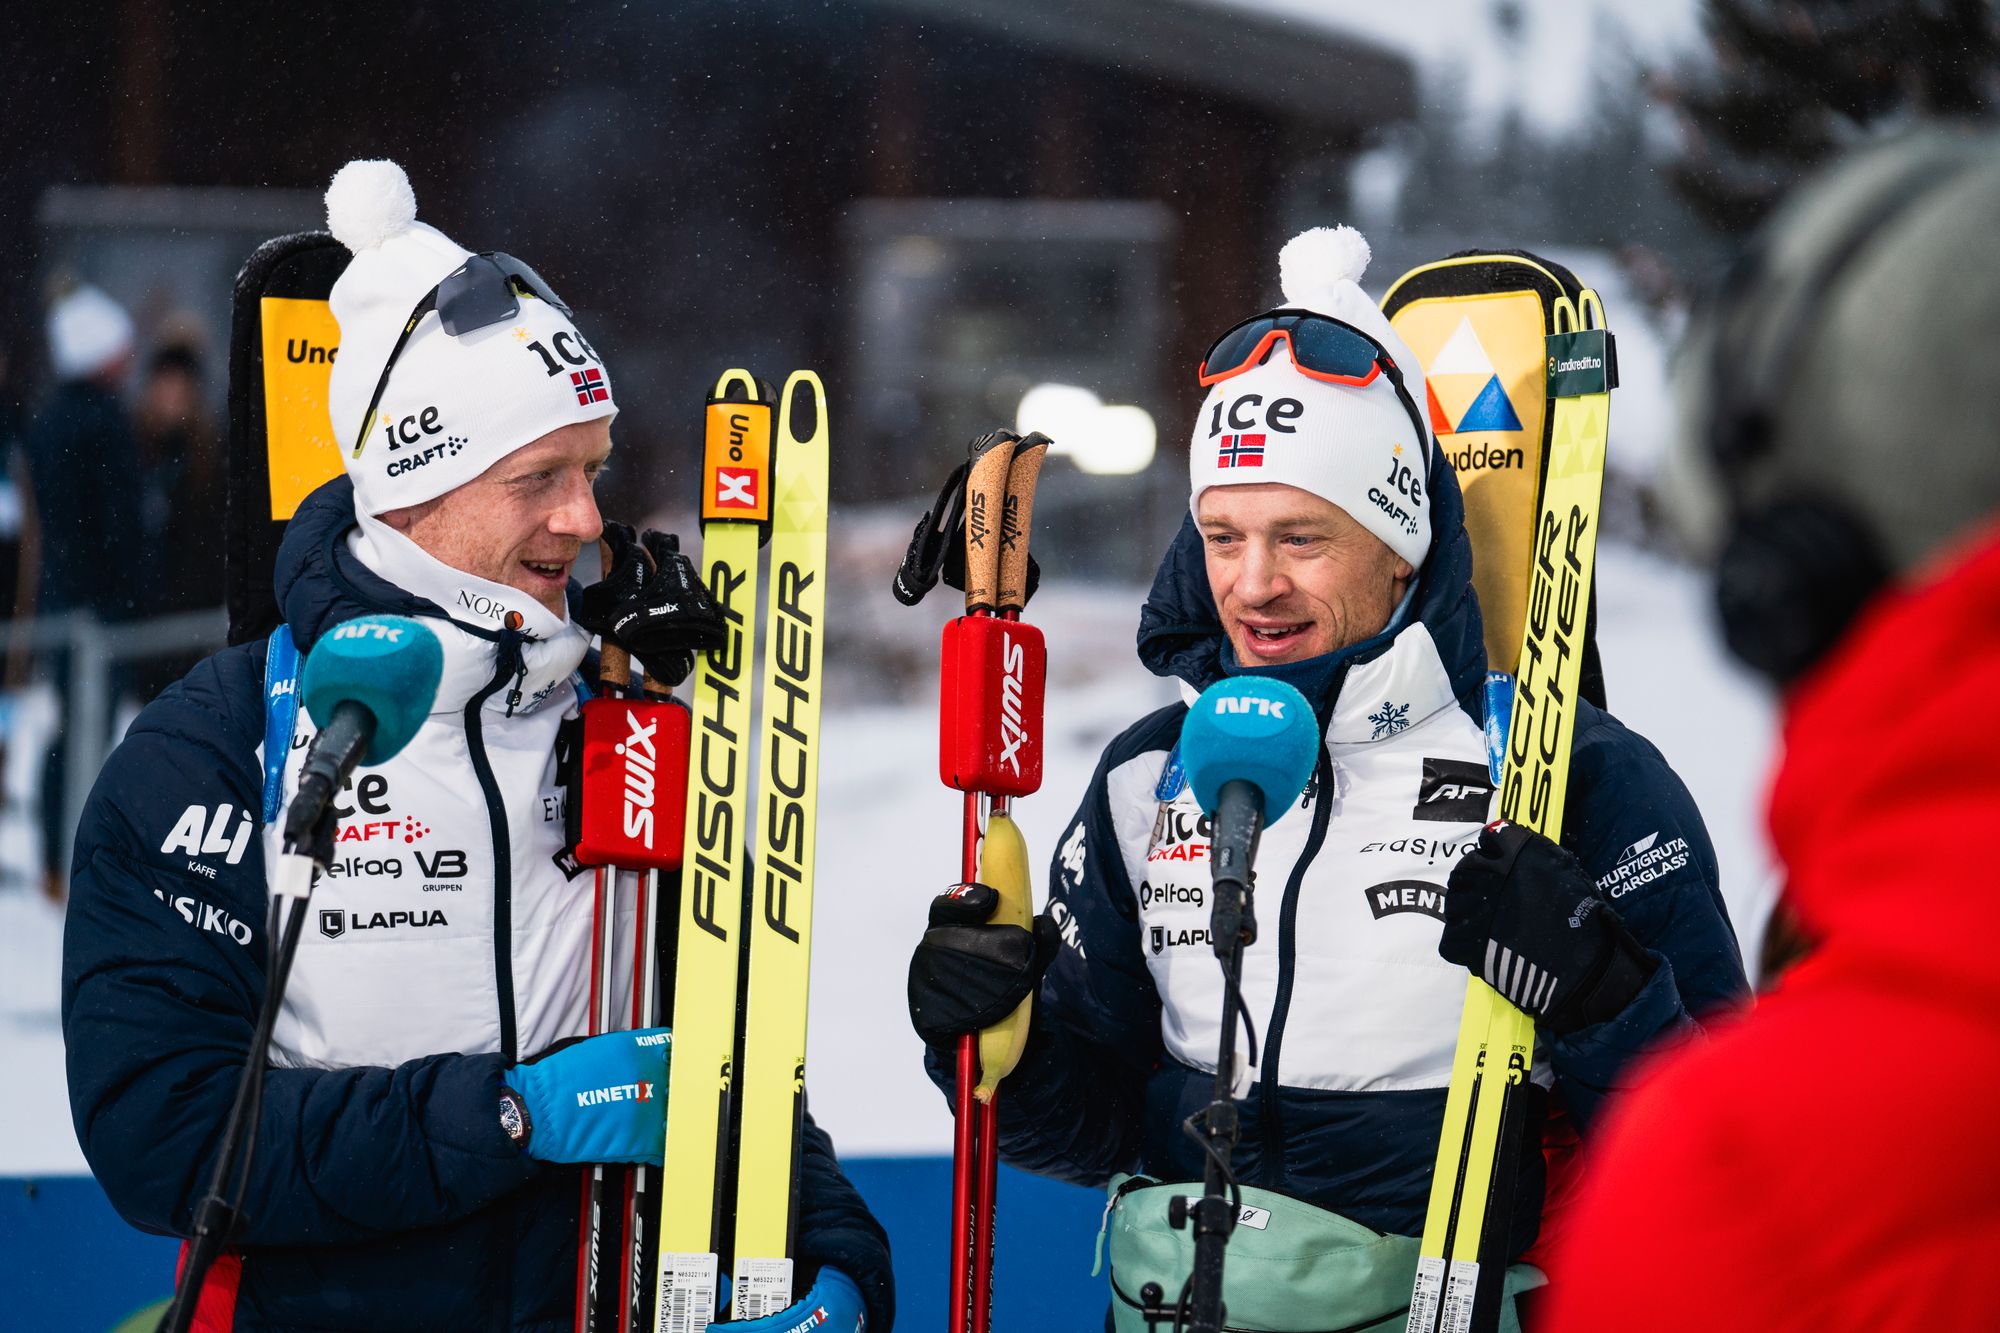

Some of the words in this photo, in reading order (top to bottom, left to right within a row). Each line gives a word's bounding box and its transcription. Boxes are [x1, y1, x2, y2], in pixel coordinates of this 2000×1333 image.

[1557, 357, 1602, 372] Landkreditt.no
[384, 405, 443, 451] ice
[1208, 393, 1304, 439] ice
[729, 414, 750, 462] Uno
[386, 443, 446, 478] CRAFT
[1387, 456, 1422, 507] ice
[1368, 487, 1410, 527] CRAFT
[1501, 510, 1562, 822] SCHER
[1529, 505, 1589, 834] SCHER
[693, 560, 746, 942] FISCHER
[765, 561, 815, 944] FISCHER
[187, 860, 217, 879] KAFFE
[327, 857, 403, 879] elfag
[414, 850, 468, 878] VB
[1595, 837, 1688, 891] HURTIGRUTA
[422, 884, 463, 892] GRUPPEN
[1154, 883, 1204, 908] elfag
[352, 910, 449, 930] LAPUA
[1167, 929, 1214, 946] LAPU
